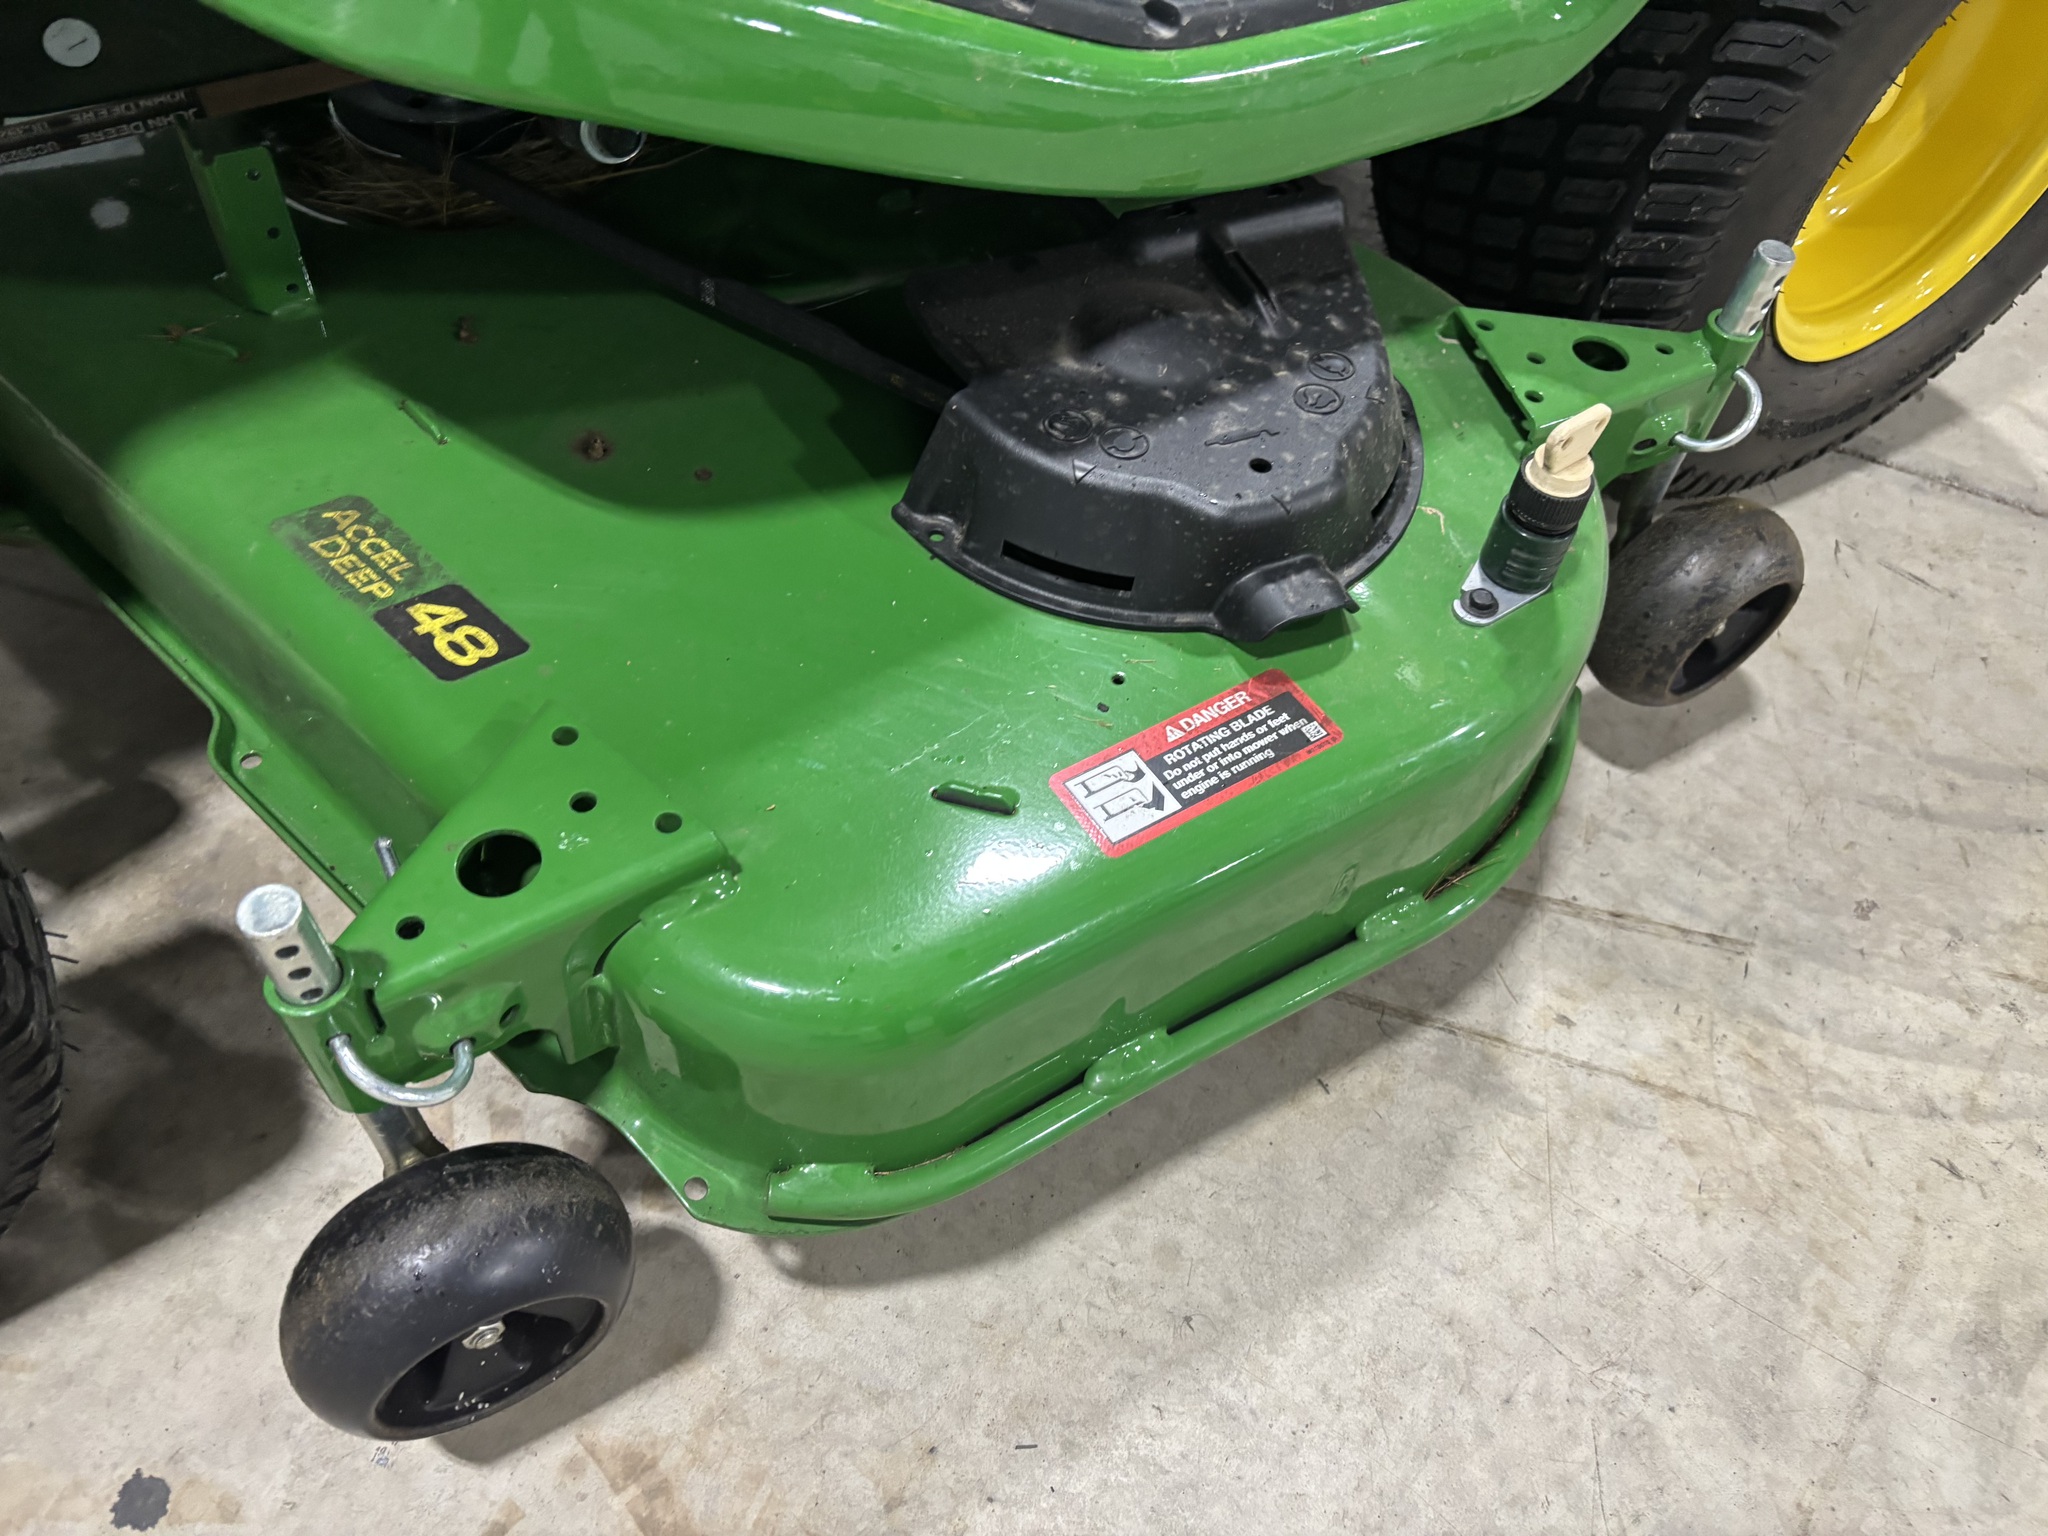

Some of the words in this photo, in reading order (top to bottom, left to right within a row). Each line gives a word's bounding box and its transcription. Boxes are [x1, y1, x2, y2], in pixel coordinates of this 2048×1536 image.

[78, 122, 146, 145] DEERE
[308, 534, 395, 599] DEEP
[321, 509, 414, 582] ACCEL
[405, 602, 499, 667] 48
[1163, 726, 1233, 766] ROTATING
[1229, 704, 1276, 733] BLADE
[1179, 690, 1253, 731] DANGER
[1163, 767, 1182, 781] Do
[1181, 755, 1204, 772] not
[1201, 745, 1224, 763] put
[1221, 730, 1256, 752] hands
[1256, 724, 1269, 735] or
[1266, 712, 1291, 729] feet
[1172, 768, 1207, 790] under
[1206, 761, 1220, 774] or
[1218, 748, 1243, 767] into
[1241, 731, 1280, 755] mower
[1277, 716, 1309, 736] when
[1180, 775, 1220, 800] engine
[1218, 769, 1232, 781] is
[1230, 747, 1275, 774] running
